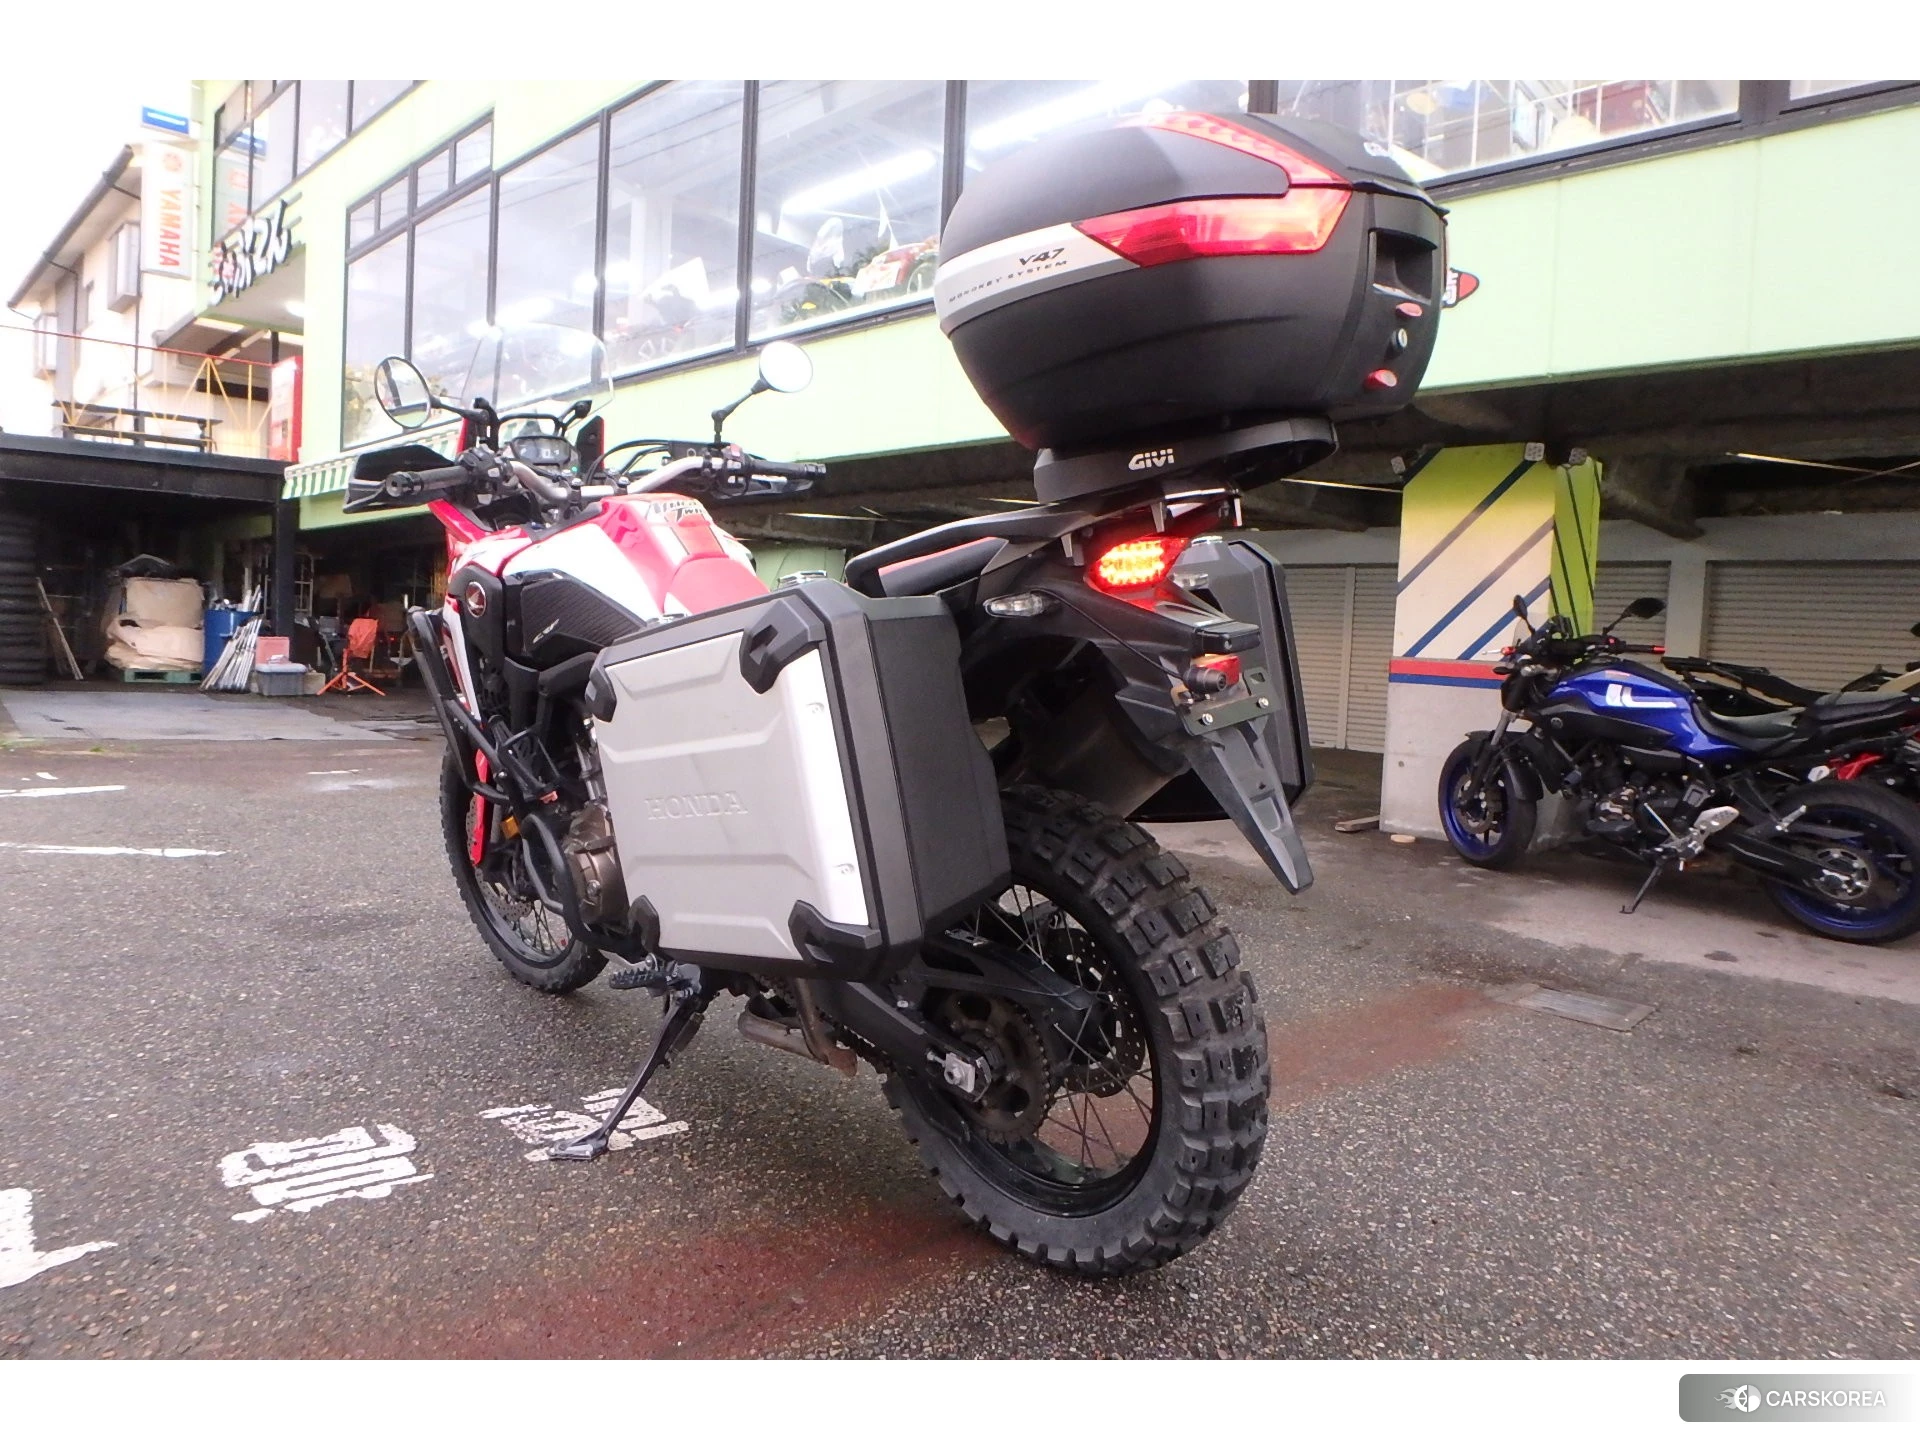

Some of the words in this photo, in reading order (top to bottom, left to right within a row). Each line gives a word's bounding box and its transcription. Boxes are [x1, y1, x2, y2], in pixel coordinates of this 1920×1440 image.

[159, 189, 182, 267] YAMAHA
[1018, 247, 1065, 266] V47
[1128, 448, 1175, 471] GIVI
[644, 791, 748, 820] HONDA
